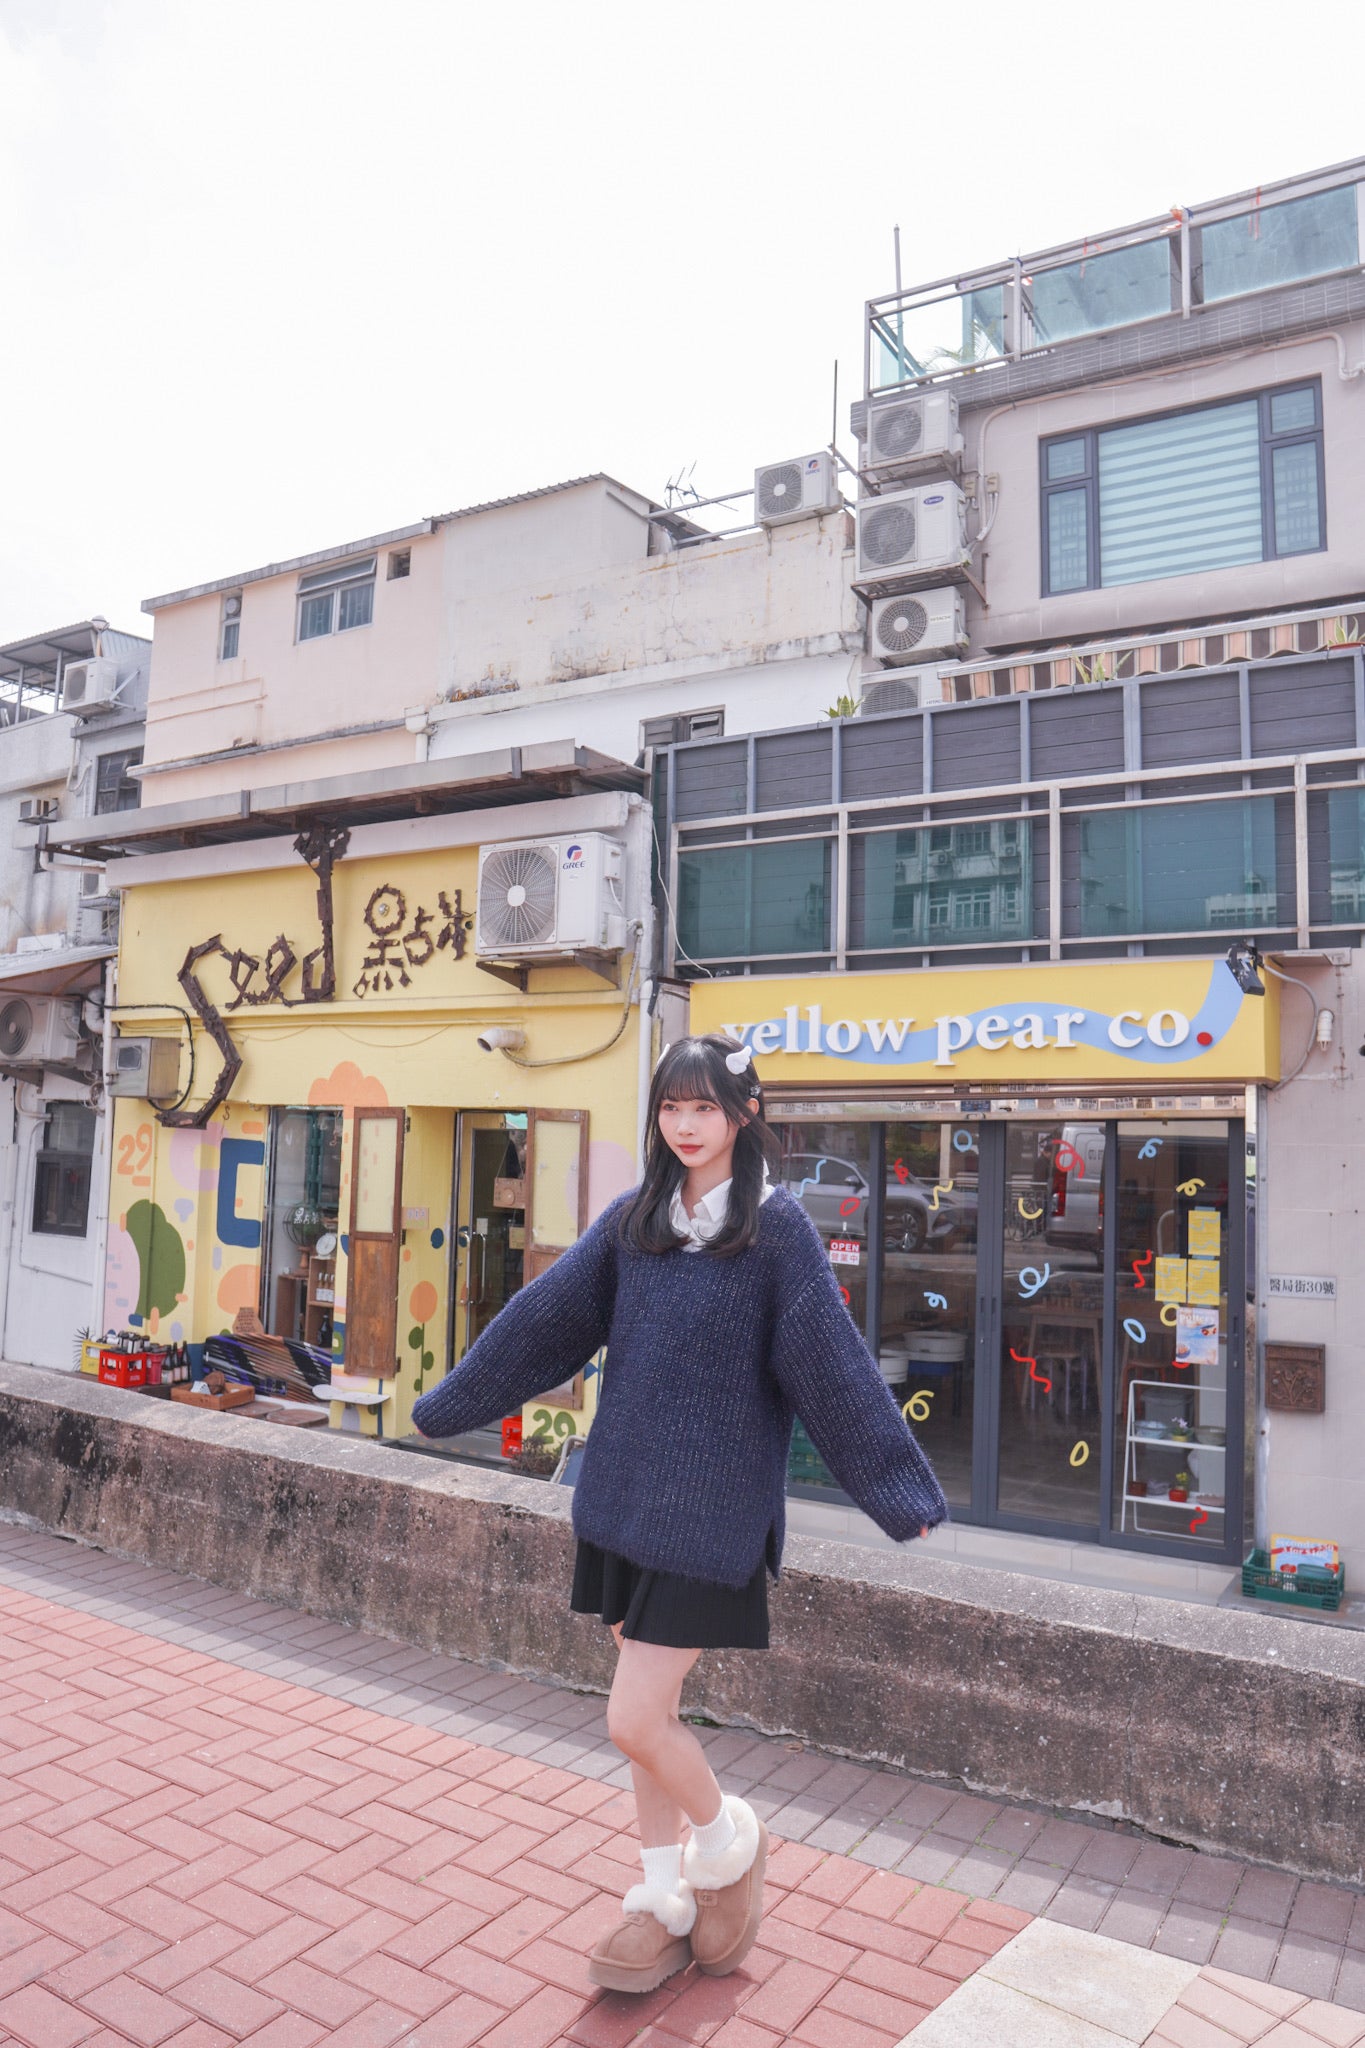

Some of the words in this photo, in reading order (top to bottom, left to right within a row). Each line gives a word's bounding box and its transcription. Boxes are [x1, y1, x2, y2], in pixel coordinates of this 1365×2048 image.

[562, 861, 586, 870] GREE
[933, 1011, 1085, 1066] pear
[1107, 1009, 1213, 1048] co.
[117, 1123, 153, 1176] 29
[831, 1242, 859, 1252] OPEN
[1269, 1278, 1334, 1295] 醫局街30號
[533, 1409, 577, 1446] 29
